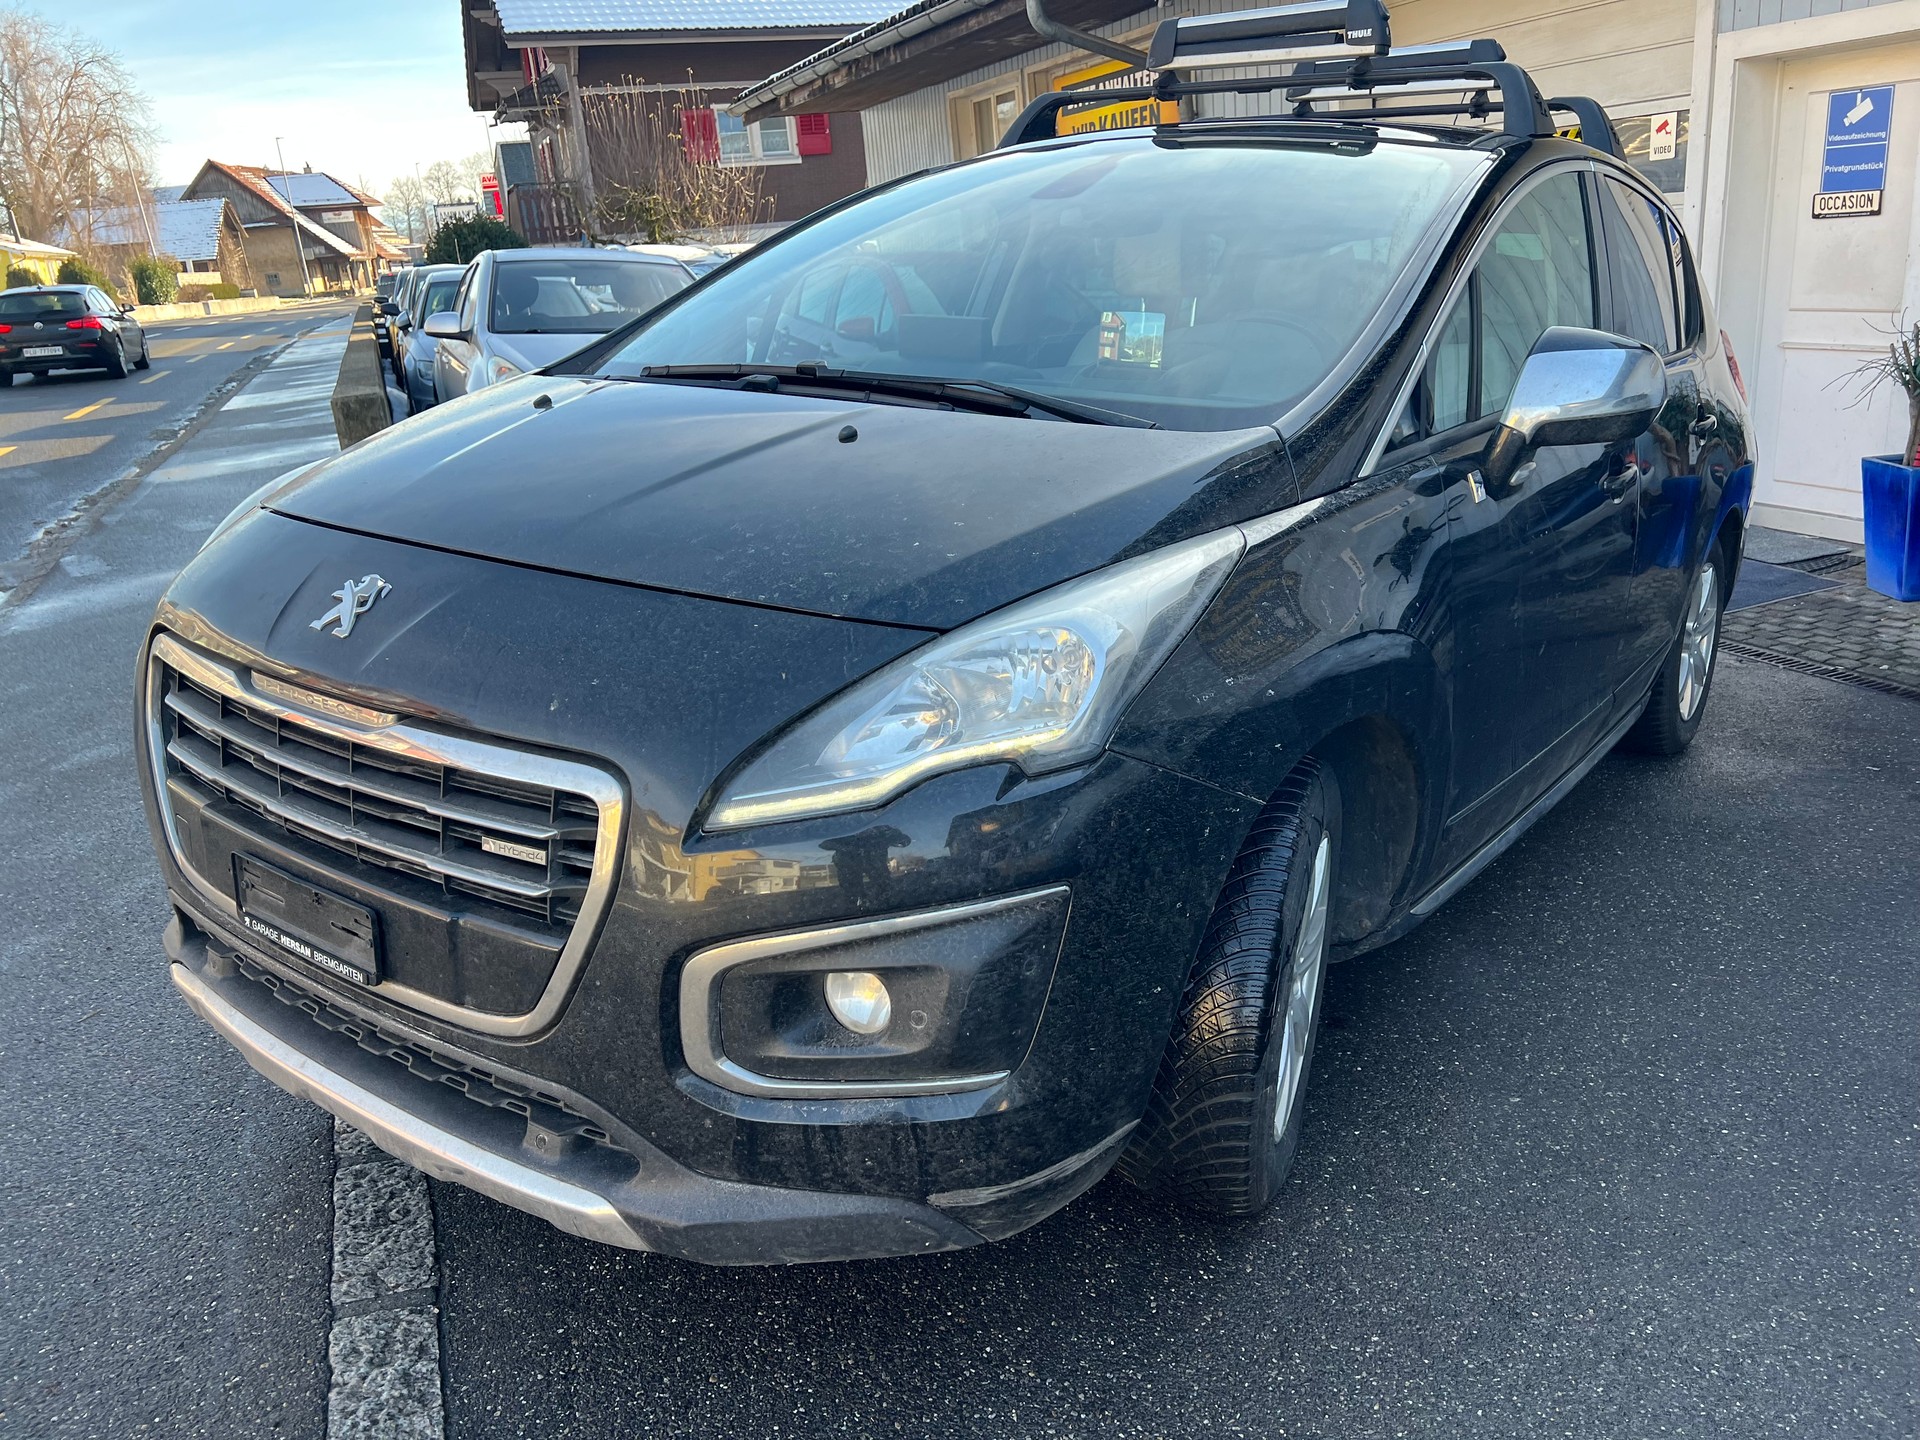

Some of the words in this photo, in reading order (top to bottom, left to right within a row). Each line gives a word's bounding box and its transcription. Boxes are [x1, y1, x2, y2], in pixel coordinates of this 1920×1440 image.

[1347, 28, 1372, 39] THULE
[1828, 131, 1886, 142] Videoaufzeichnung
[1653, 145, 1672, 155] VIDEO
[1824, 162, 1884, 173] Privatgrundstück
[1819, 193, 1874, 211] OCCASION
[498, 843, 544, 862] HYbrid4
[252, 920, 279, 942] GARAGE
[280, 934, 311, 958] HERSAN
[313, 950, 363, 983] BREMGARTEN
